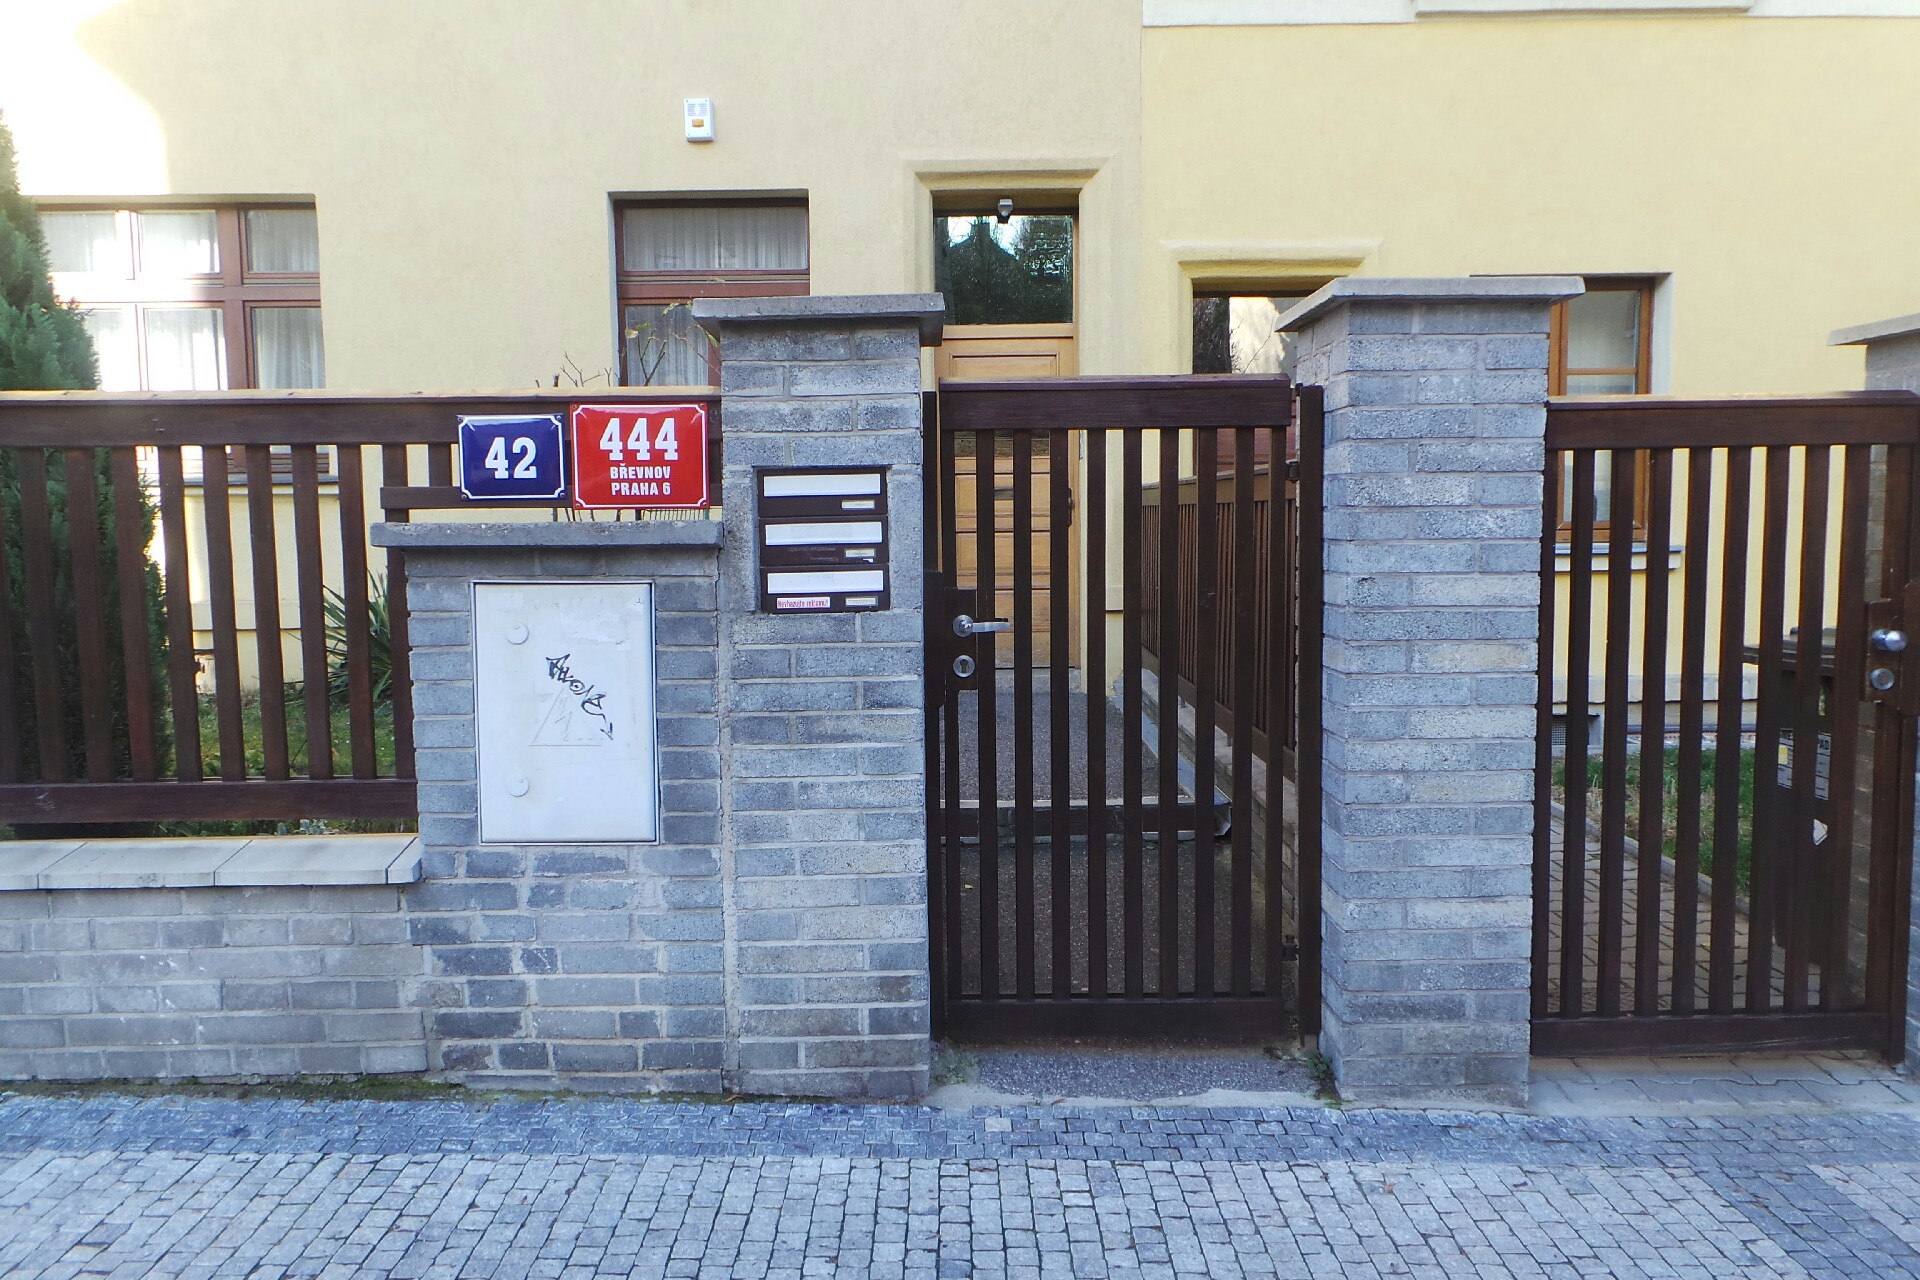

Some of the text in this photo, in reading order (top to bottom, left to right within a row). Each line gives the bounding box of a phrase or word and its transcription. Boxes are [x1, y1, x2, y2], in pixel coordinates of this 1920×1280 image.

[600, 418, 678, 461] 444
[485, 437, 537, 479] 42
[610, 463, 671, 479] BŘEVNOV
[612, 482, 671, 496] PRAHA 6
